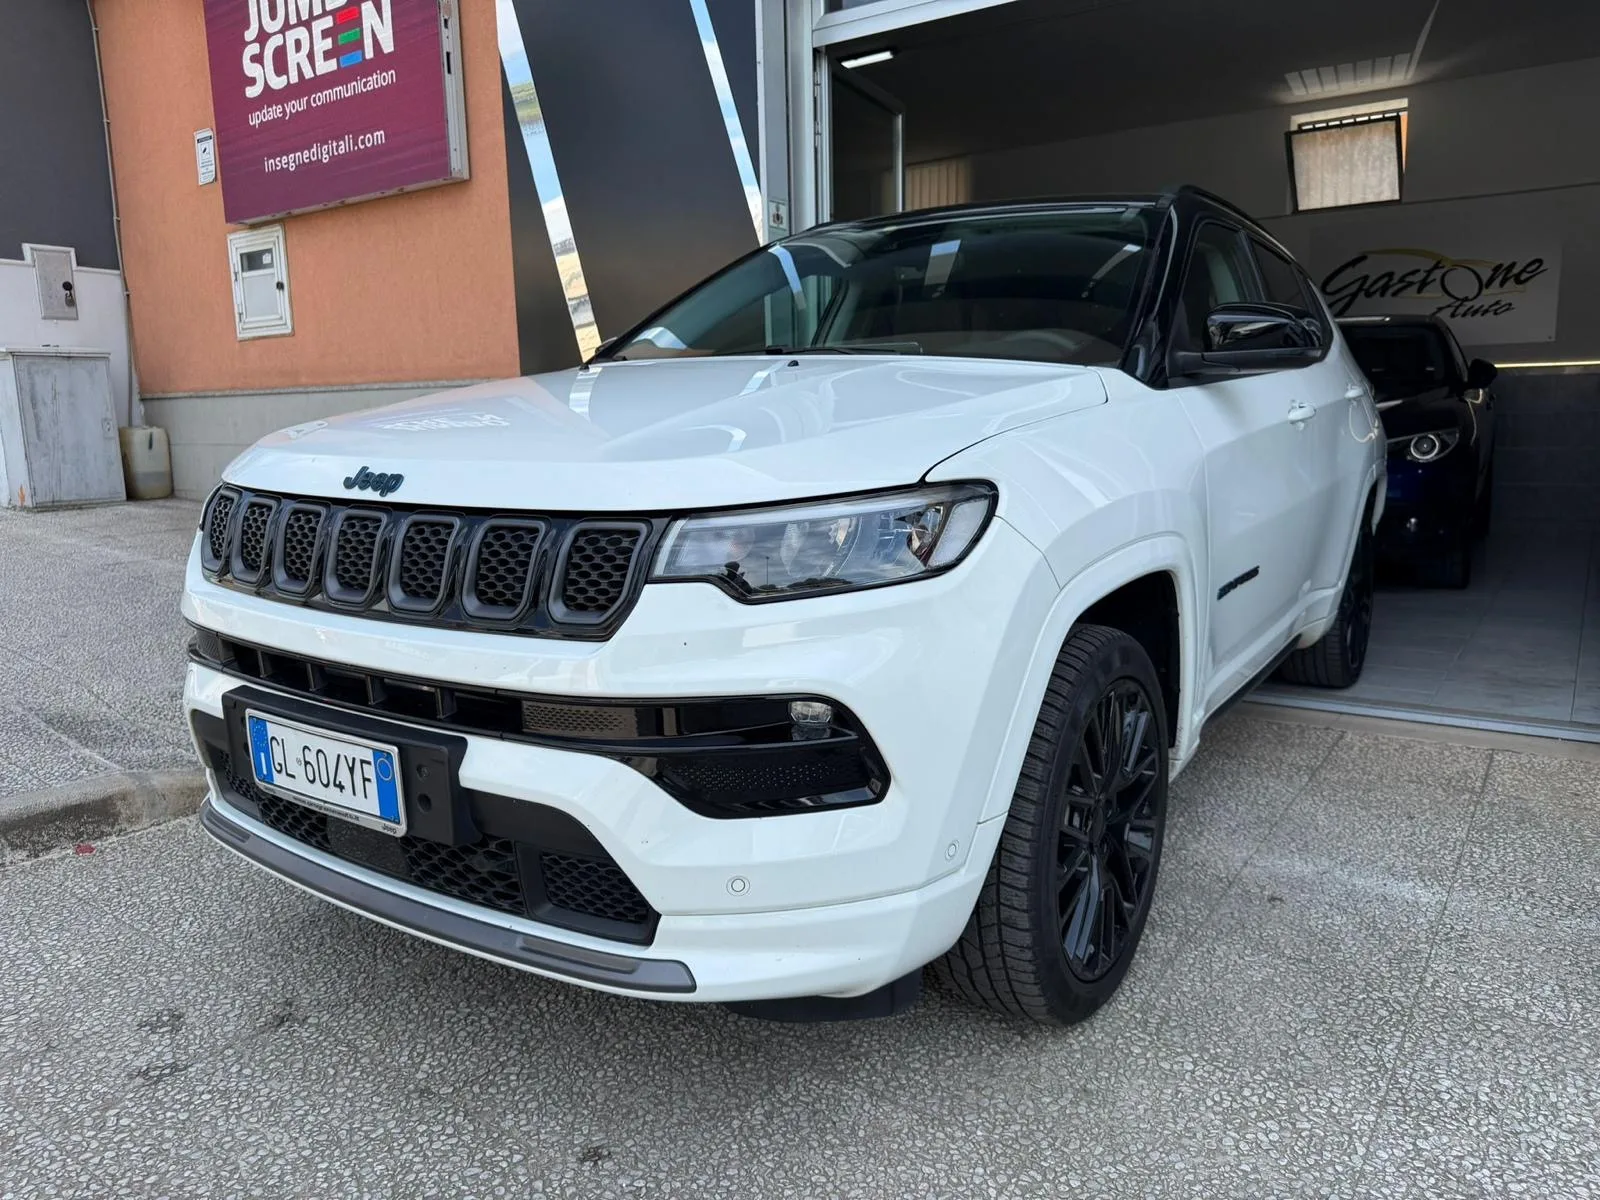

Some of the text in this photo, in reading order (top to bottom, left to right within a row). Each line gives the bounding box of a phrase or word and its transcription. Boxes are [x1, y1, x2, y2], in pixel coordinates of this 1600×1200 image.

[244, 0, 348, 42] JU
[242, 0, 395, 98] SCREEN
[248, 69, 396, 127] update your communication
[264, 129, 385, 173] insegnedigitali.com
[1430, 297, 1516, 319] Auto
[343, 465, 404, 497] Jeep
